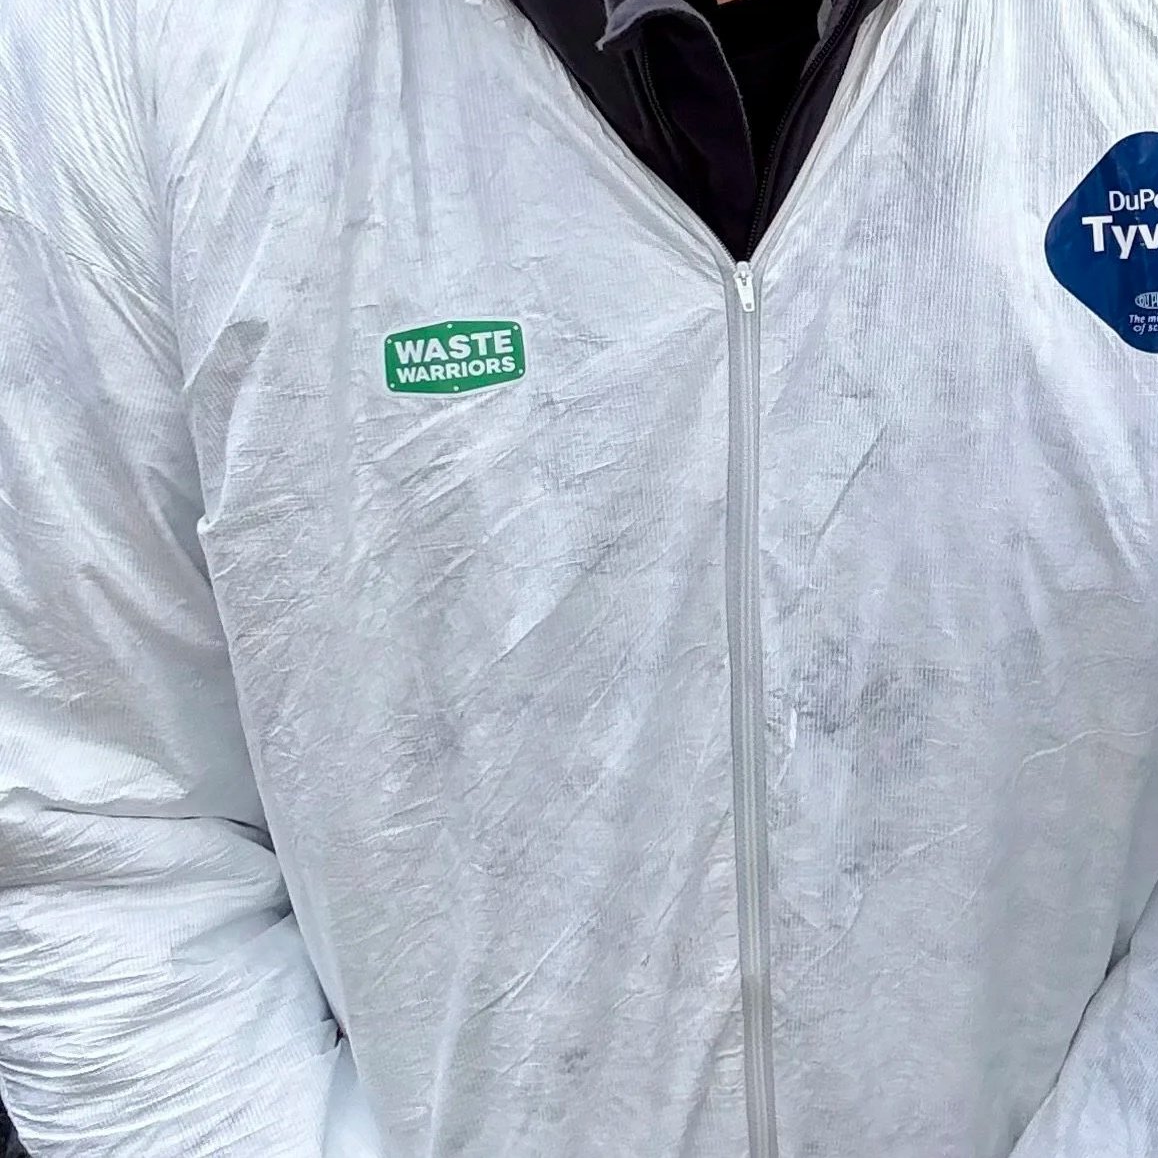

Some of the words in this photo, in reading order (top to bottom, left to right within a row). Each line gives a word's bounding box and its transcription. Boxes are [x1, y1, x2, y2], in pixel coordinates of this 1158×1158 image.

[1129, 314, 1146, 324] The
[1133, 323, 1146, 335] of
[395, 329, 514, 364] WASTE
[396, 356, 516, 383] WARRIORS
